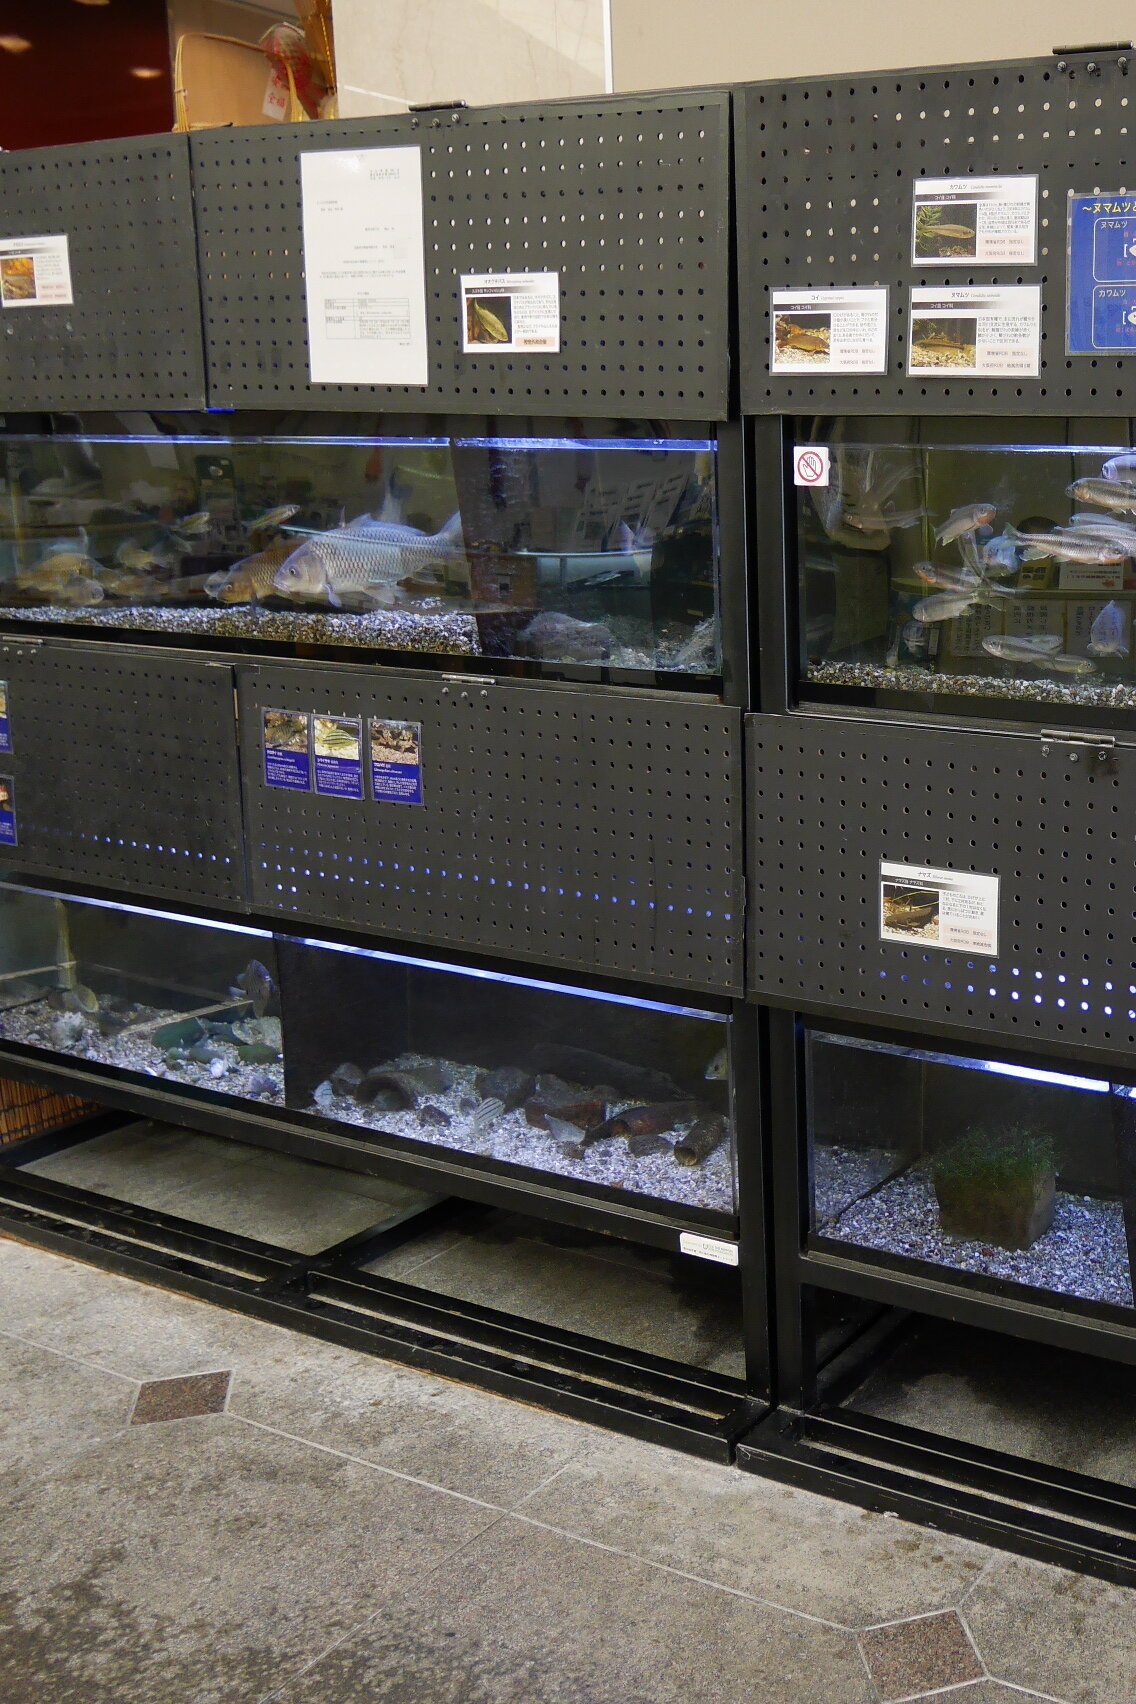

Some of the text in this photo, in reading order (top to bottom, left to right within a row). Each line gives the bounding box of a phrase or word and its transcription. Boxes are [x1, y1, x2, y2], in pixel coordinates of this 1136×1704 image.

[1101, 220, 1128, 229] ヌマムツ
[1098, 289, 1126, 298] カワムツ
